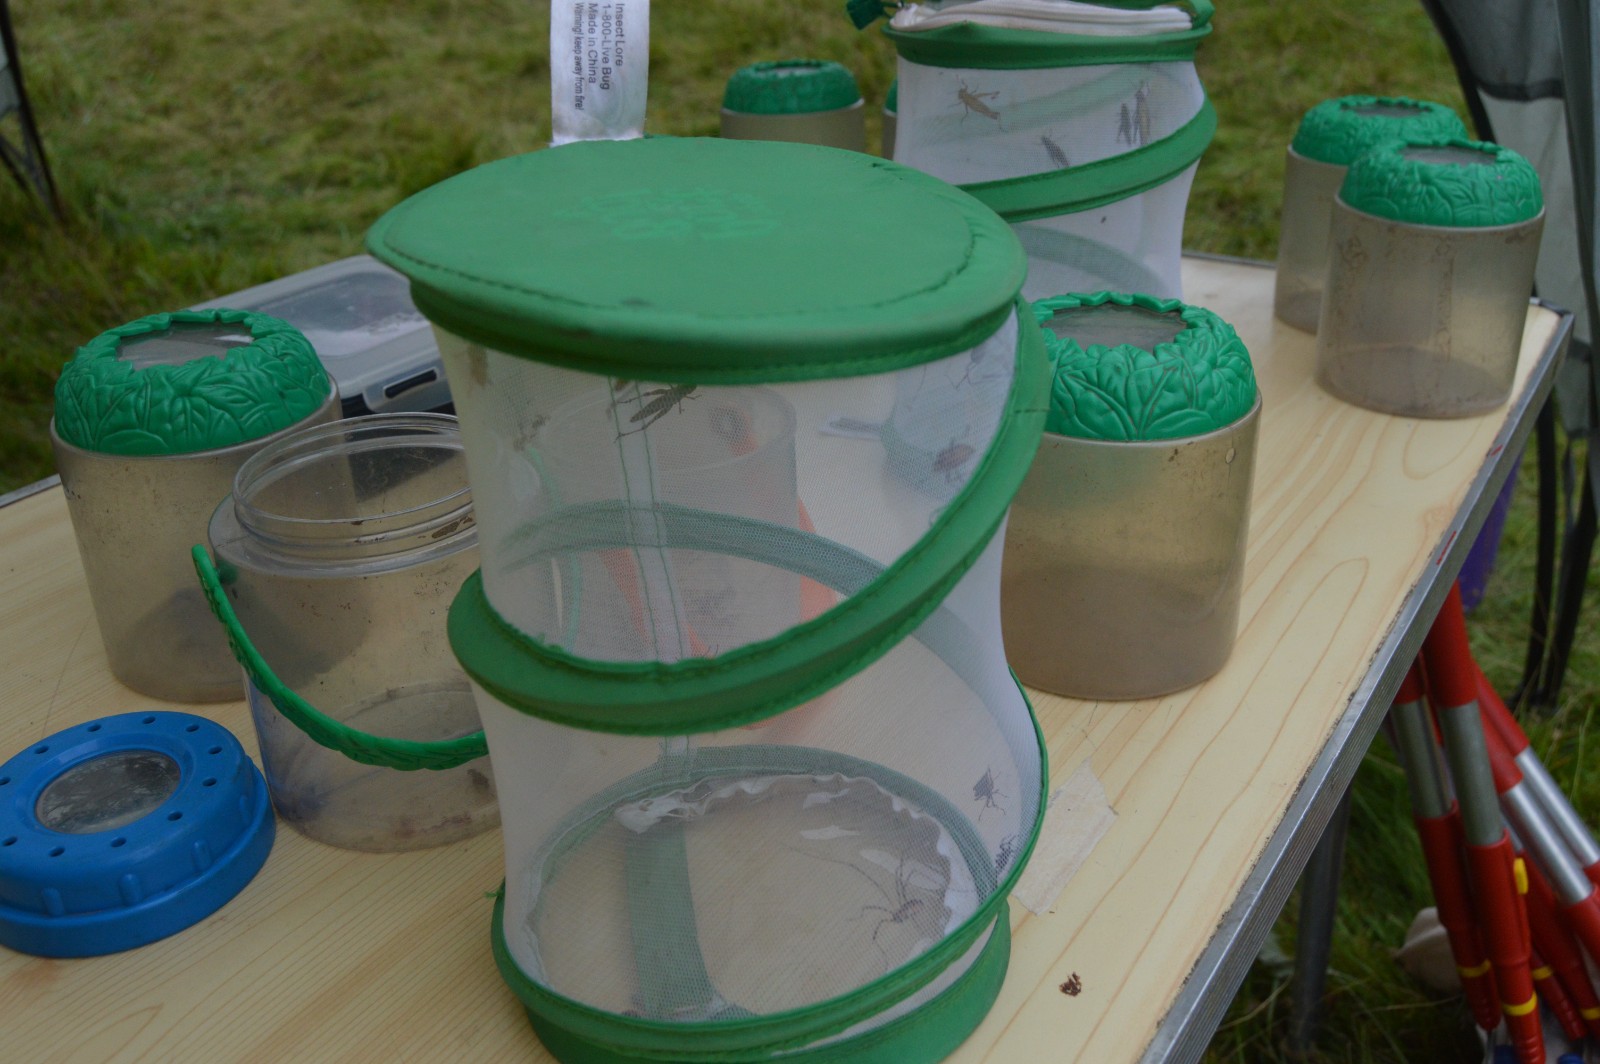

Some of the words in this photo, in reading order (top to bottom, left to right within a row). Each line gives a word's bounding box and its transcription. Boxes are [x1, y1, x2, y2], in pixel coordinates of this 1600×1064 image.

[572, 3, 584, 35] Warning!
[587, 3, 598, 34] Made
[615, 3, 625, 37] Insect
[572, 36, 584, 55] keep
[588, 37, 598, 47] in
[601, 3, 612, 64] 1-800-Live
[573, 56, 583, 75] away
[615, 40, 625, 67] Lore
[587, 49, 598, 84] China
[600, 67, 612, 90] Bug
[574, 77, 584, 94] from
[575, 95, 585, 110] fire!
